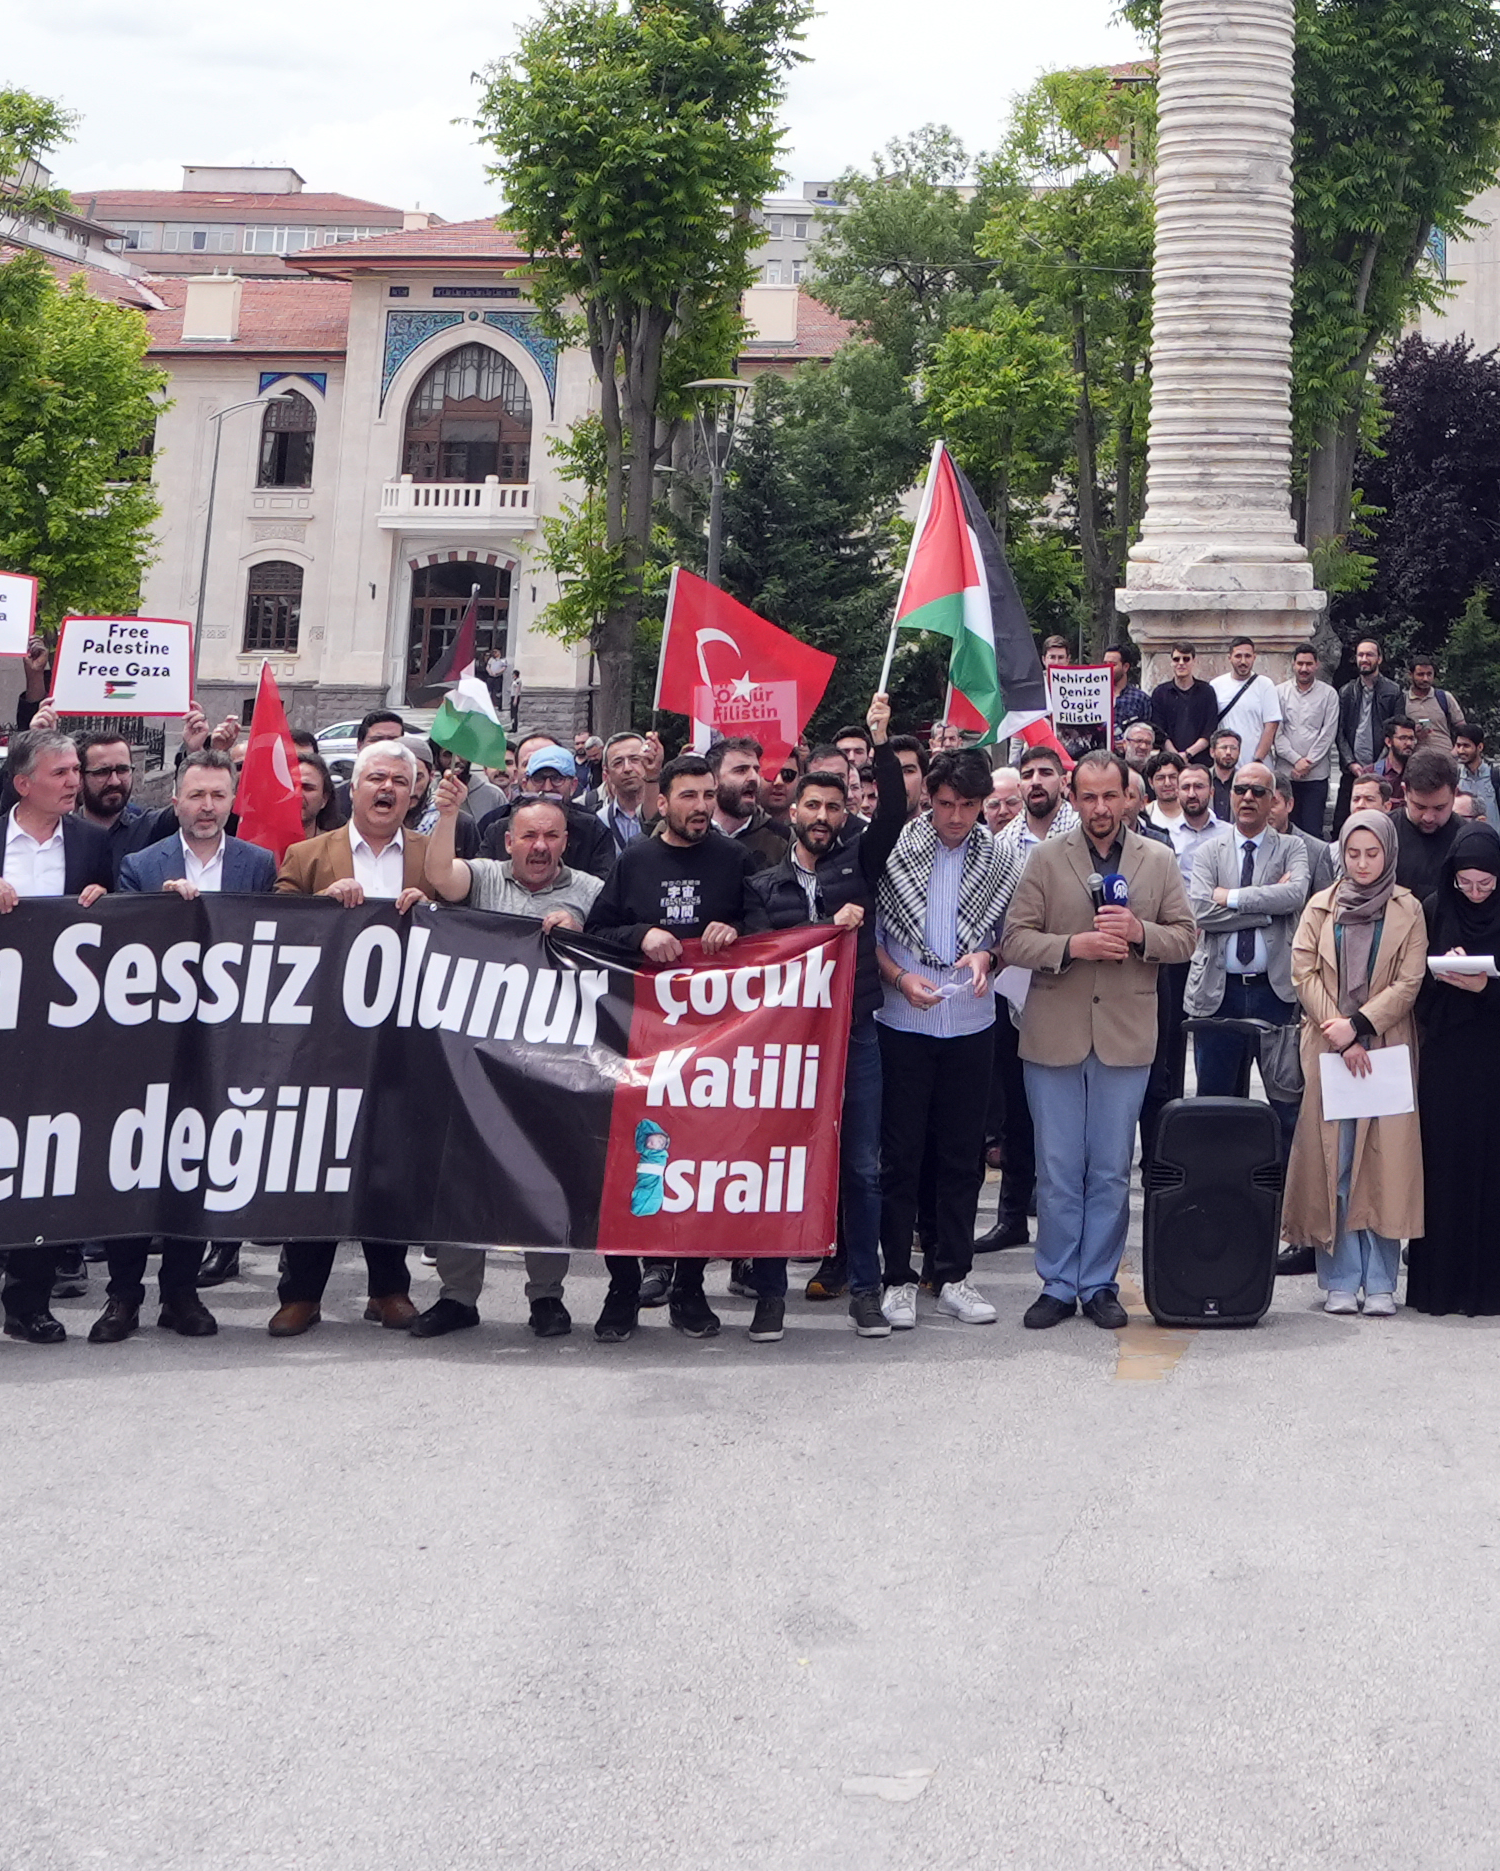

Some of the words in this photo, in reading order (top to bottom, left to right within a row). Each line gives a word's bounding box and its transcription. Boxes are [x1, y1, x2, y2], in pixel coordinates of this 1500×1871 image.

[108, 624, 149, 639] Free
[82, 640, 170, 655] Palestine
[78, 662, 120, 678] Free
[125, 662, 171, 678] Gaza
[1052, 673, 1108, 683] Nehirden
[1059, 686, 1101, 696] Denize
[713, 704, 778, 722] Filistin
[1061, 697, 1099, 713] Özgür
[1059, 712, 1102, 723] Filistin
[47, 921, 324, 1031] Sessiz
[342, 924, 610, 1048] Olunur
[654, 947, 835, 1025] Çocuk
[646, 1044, 820, 1110] Katili
[109, 1083, 363, 1212] değil!
